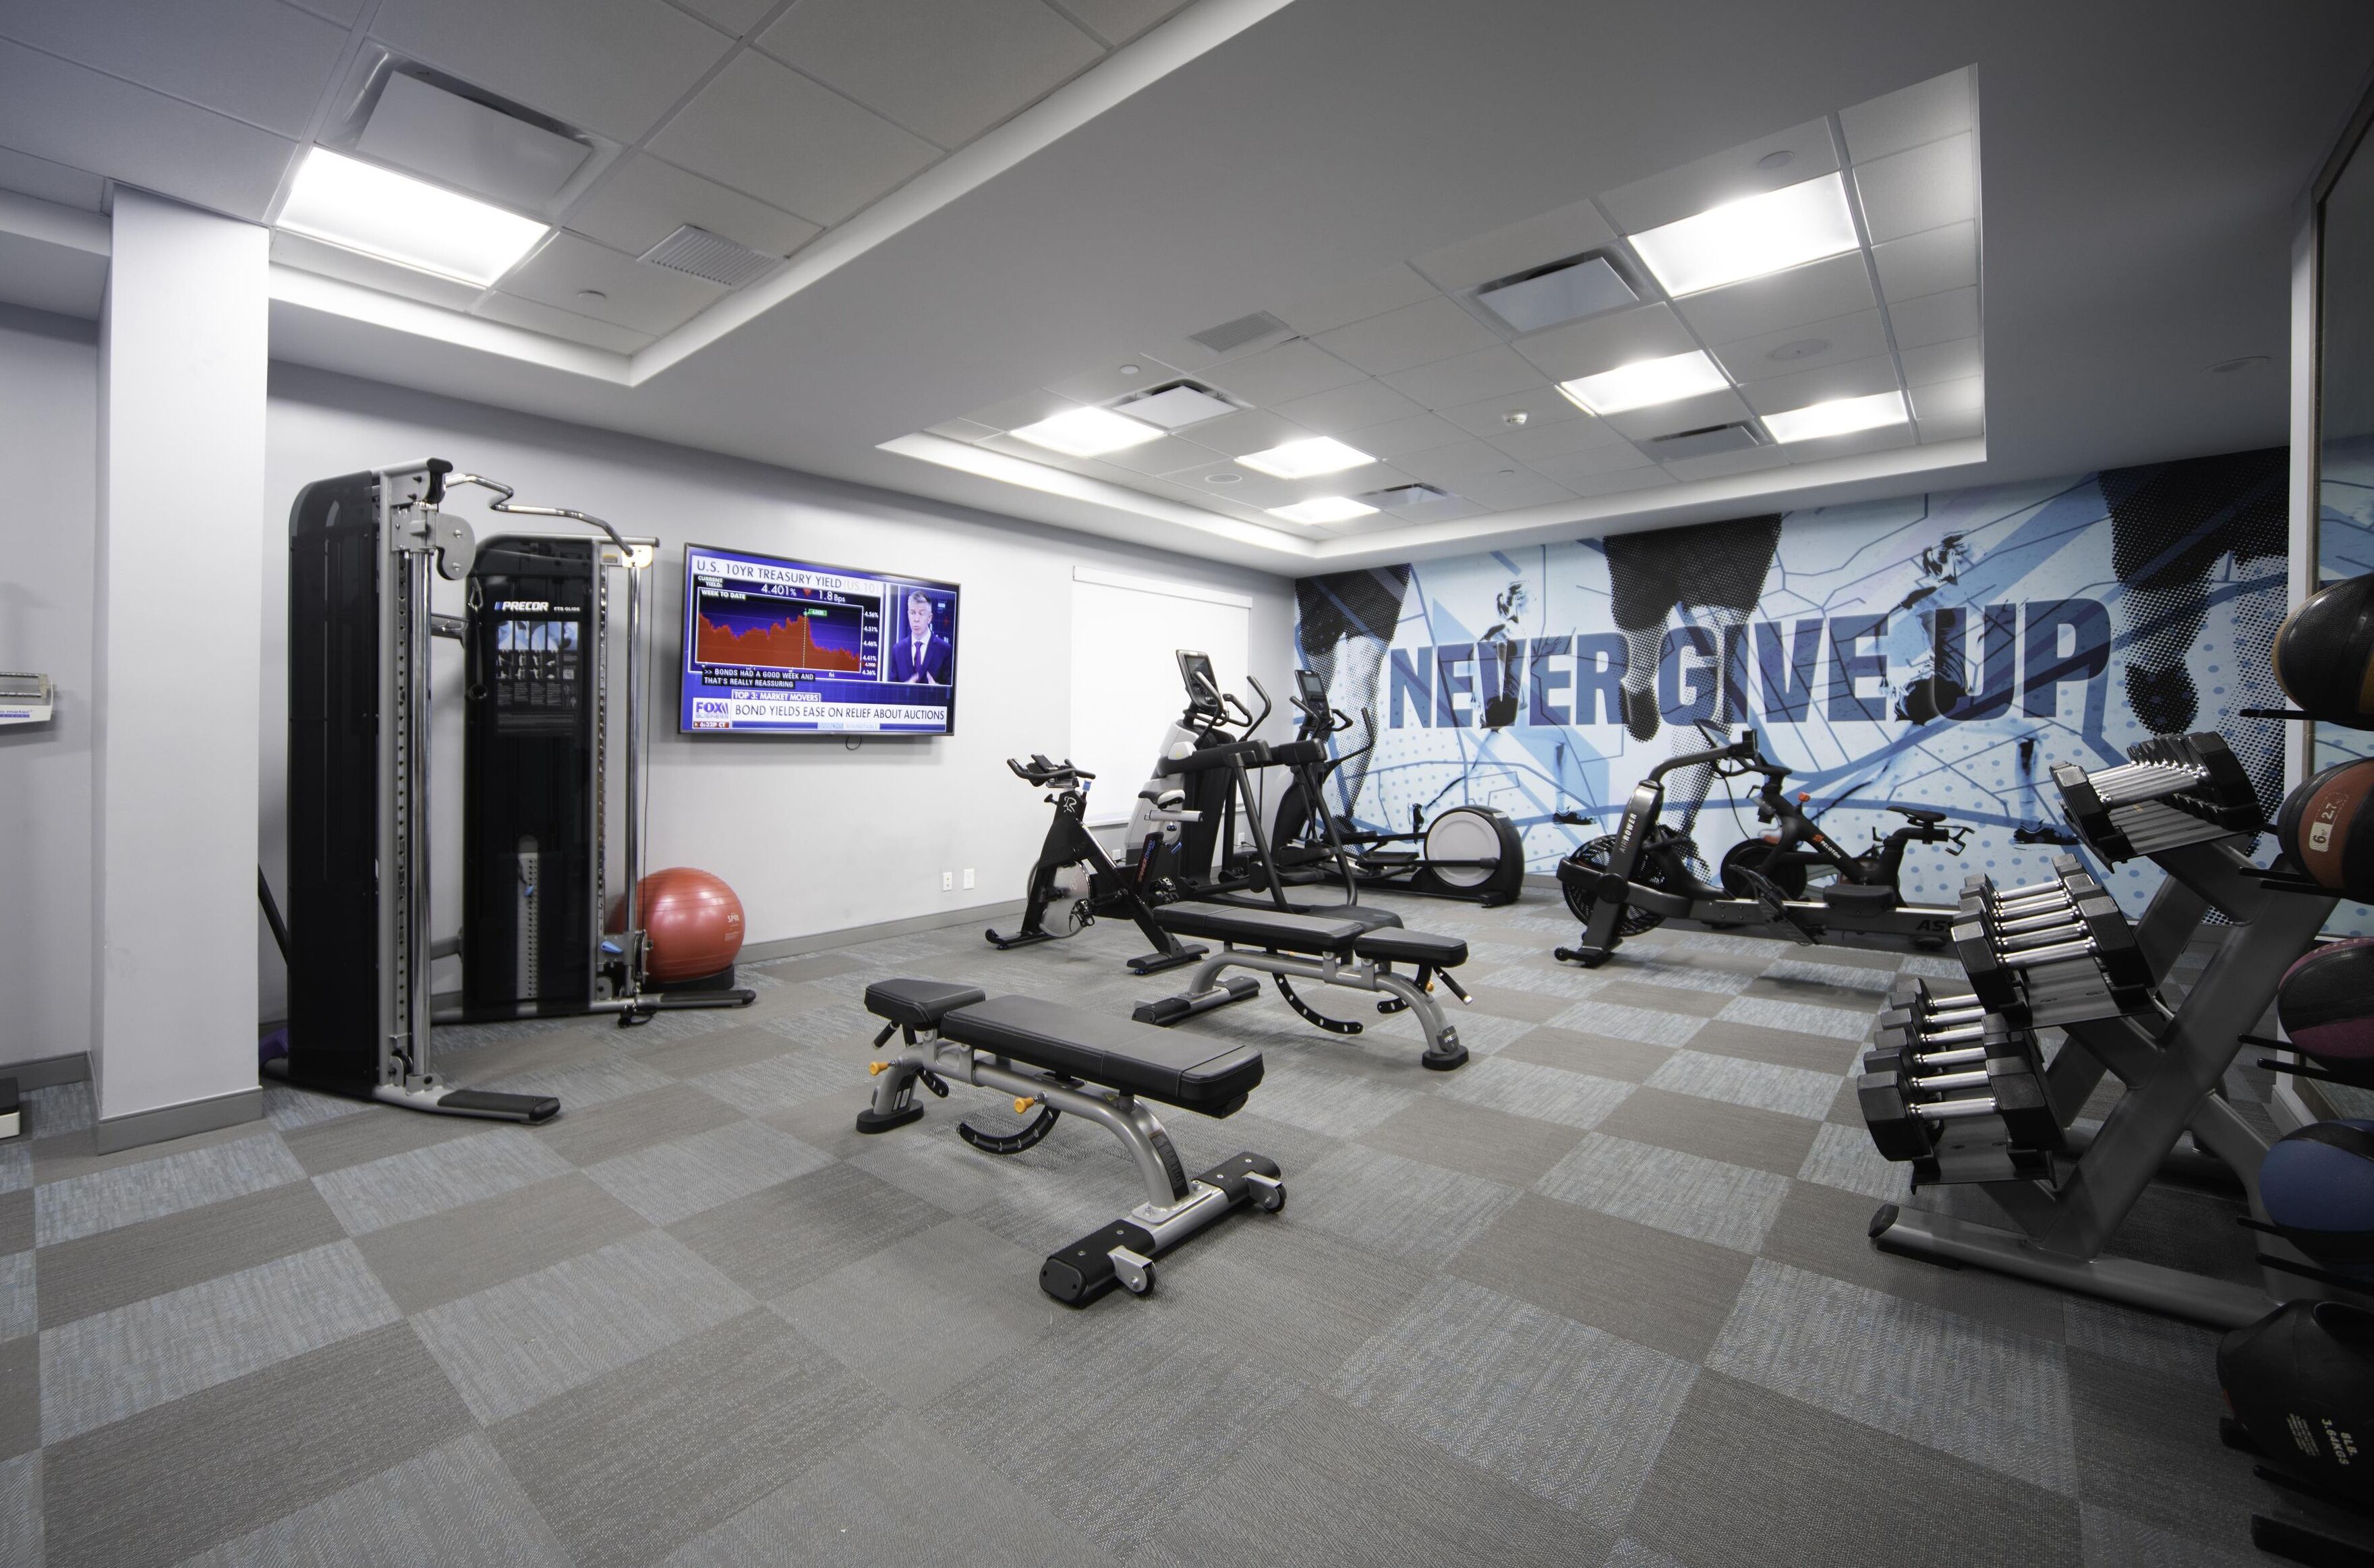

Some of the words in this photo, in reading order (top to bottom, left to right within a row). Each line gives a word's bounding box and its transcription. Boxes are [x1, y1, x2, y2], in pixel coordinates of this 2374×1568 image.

[697, 560, 720, 573] U.S.
[726, 564, 753, 577] 10YR
[757, 568, 811, 584] TREASURY
[815, 576, 842, 588] YIELD
[819, 590, 833, 600] 1.8
[834, 594, 846, 603] Bps
[502, 602, 549, 612] PRECOR
[1389, 632, 1632, 728] NEVER
[1658, 613, 1888, 726] GIVE
[1934, 598, 2111, 721] UP
[730, 678, 753, 686] REALLY
[755, 679, 794, 688] REASSURING
[734, 691, 749, 699] TOP
[759, 693, 788, 701] MARKET
[790, 694, 819, 702] MOVERS
[695, 701, 724, 714] FOX
[735, 705, 766, 716] BOND
[770, 705, 801, 717] YIELDS
[803, 706, 825, 717] EASE
[828, 707, 843, 717] ON
[845, 707, 871, 718] RELIEF
[873, 709, 902, 719] ABOUT
[904, 709, 944, 720] AUCTIONS
[1821, 840, 1841, 859] PELOTON
